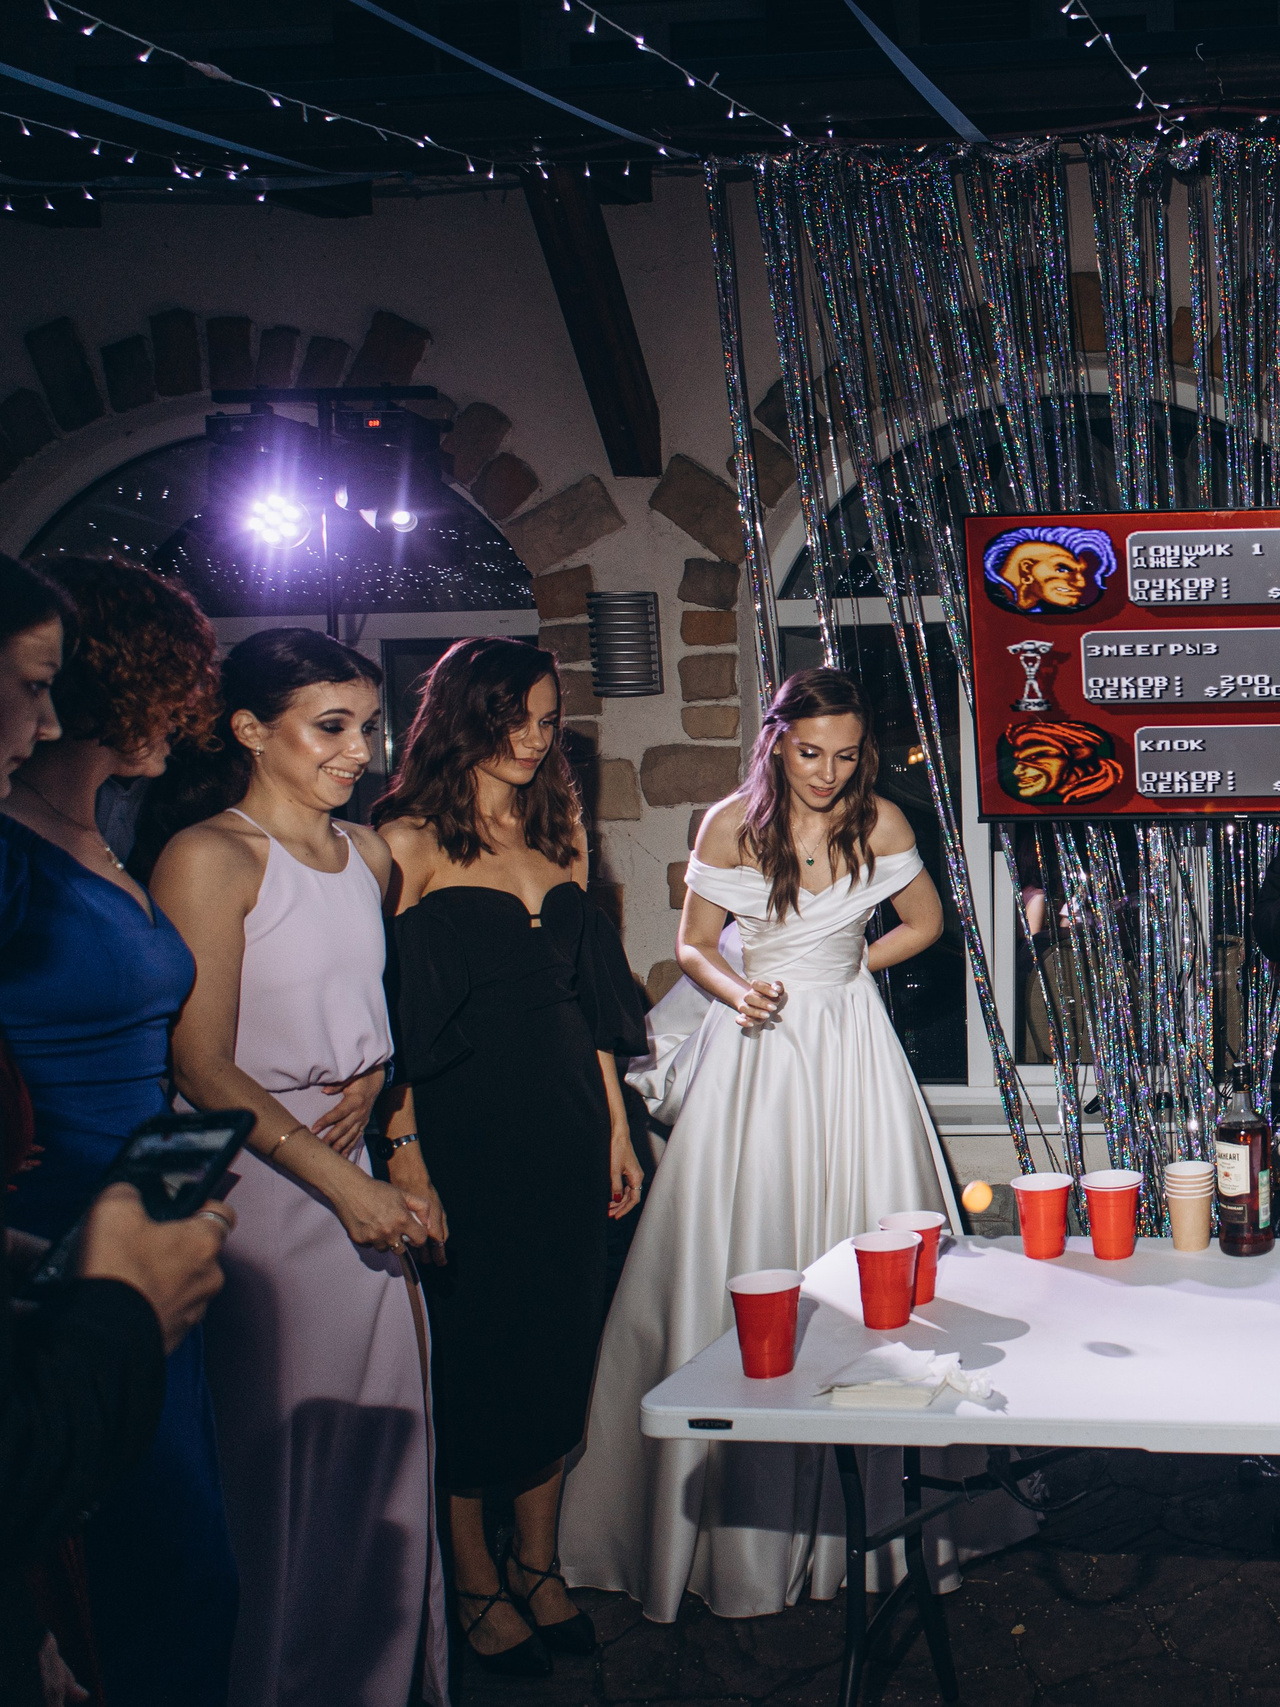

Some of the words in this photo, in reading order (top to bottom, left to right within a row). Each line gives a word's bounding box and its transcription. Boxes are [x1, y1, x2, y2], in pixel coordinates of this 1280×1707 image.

[1252, 543, 1263, 556] 1
[1132, 556, 1198, 568] ДЖЕК
[1134, 577, 1229, 590] ОЧКОВ:
[1133, 588, 1229, 601] ДЕНЕГ:
[1089, 676, 1182, 688] ОЧКОВ:
[1220, 675, 1270, 686] 200
[1088, 687, 1182, 699] ДЕНЕГ:
[1140, 739, 1205, 751] КЛОК
[1141, 770, 1235, 782] ОЧКОВ:
[1141, 781, 1235, 793] ДЕНЕГ:
